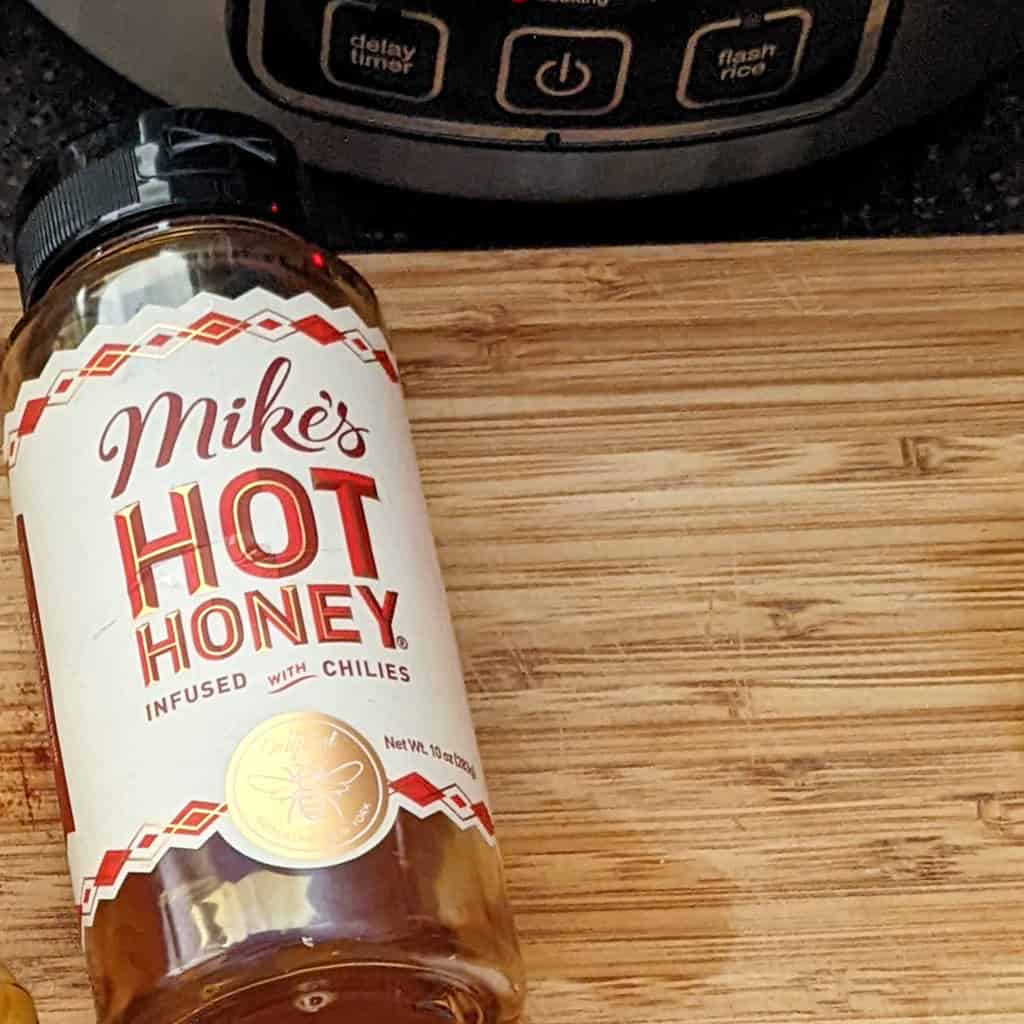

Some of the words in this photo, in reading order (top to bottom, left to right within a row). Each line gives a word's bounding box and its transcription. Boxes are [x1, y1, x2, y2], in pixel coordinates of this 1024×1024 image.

[350, 34, 416, 62] delay
[351, 48, 414, 74] timer
[719, 43, 776, 66] flash
[720, 62, 766, 80] rice
[99, 356, 369, 499] Mike's
[114, 466, 380, 620] HOT
[144, 672, 248, 722] INFUSED
[267, 662, 307, 687] WITH
[322, 660, 411, 683] CHILIES
[384, 736, 408, 752] Net
[430, 744, 442, 760] 10
